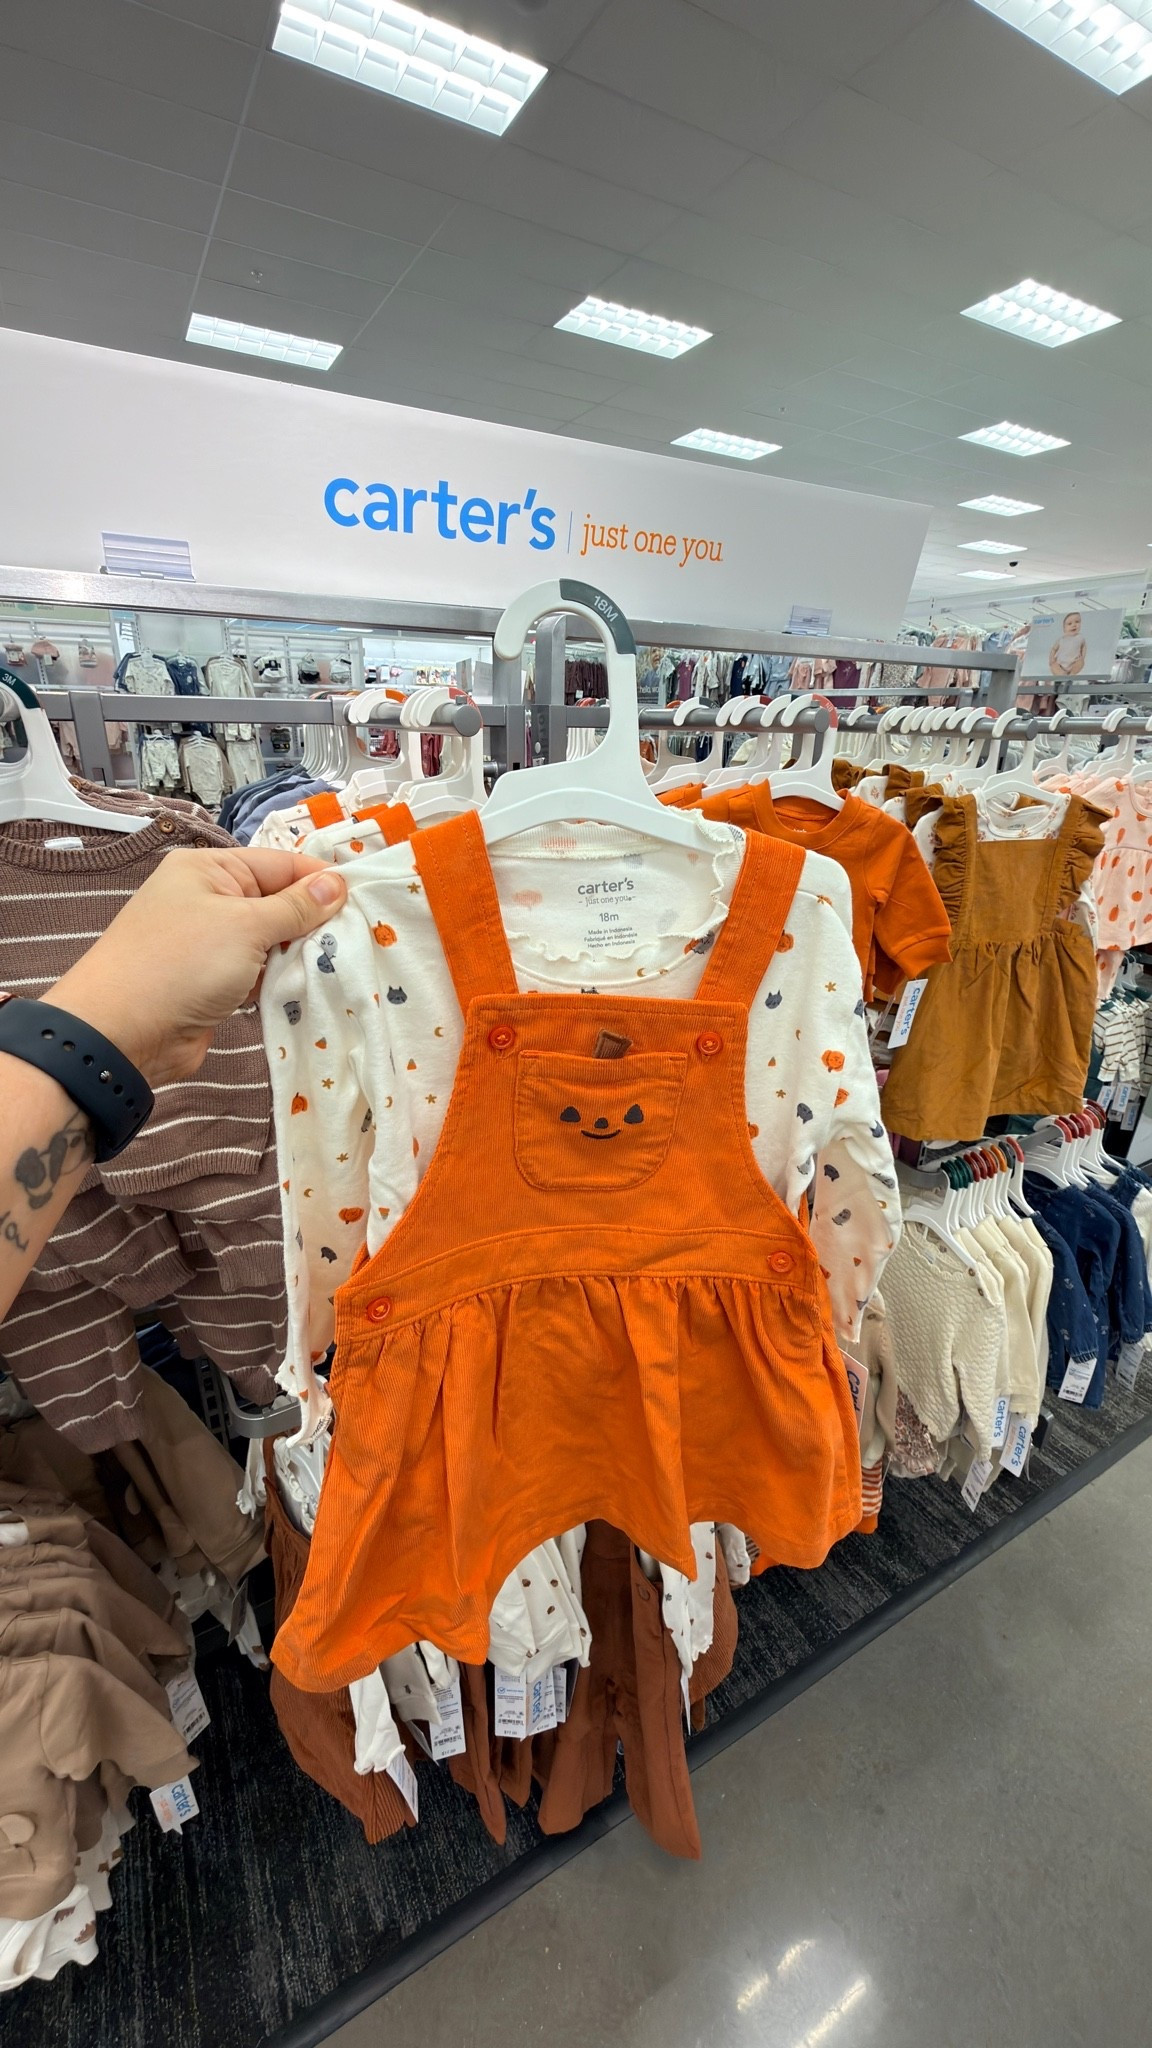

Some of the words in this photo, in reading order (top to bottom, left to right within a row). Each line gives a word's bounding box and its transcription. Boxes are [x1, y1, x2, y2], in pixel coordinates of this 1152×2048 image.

[324, 477, 556, 552] carter's
[580, 513, 629, 556] just
[634, 530, 677, 556] one
[679, 537, 722, 568] you
[594, 595, 619, 622] 18M
[2, 673, 17, 686] 3M
[577, 877, 634, 895] carter's
[585, 896, 600, 907] just
[600, 896, 614, 904] one
[599, 912, 619, 922] 18m
[900, 987, 920, 1036] carter's
[993, 1400, 1006, 1438] carter's
[1011, 1425, 1027, 1467] carter's
